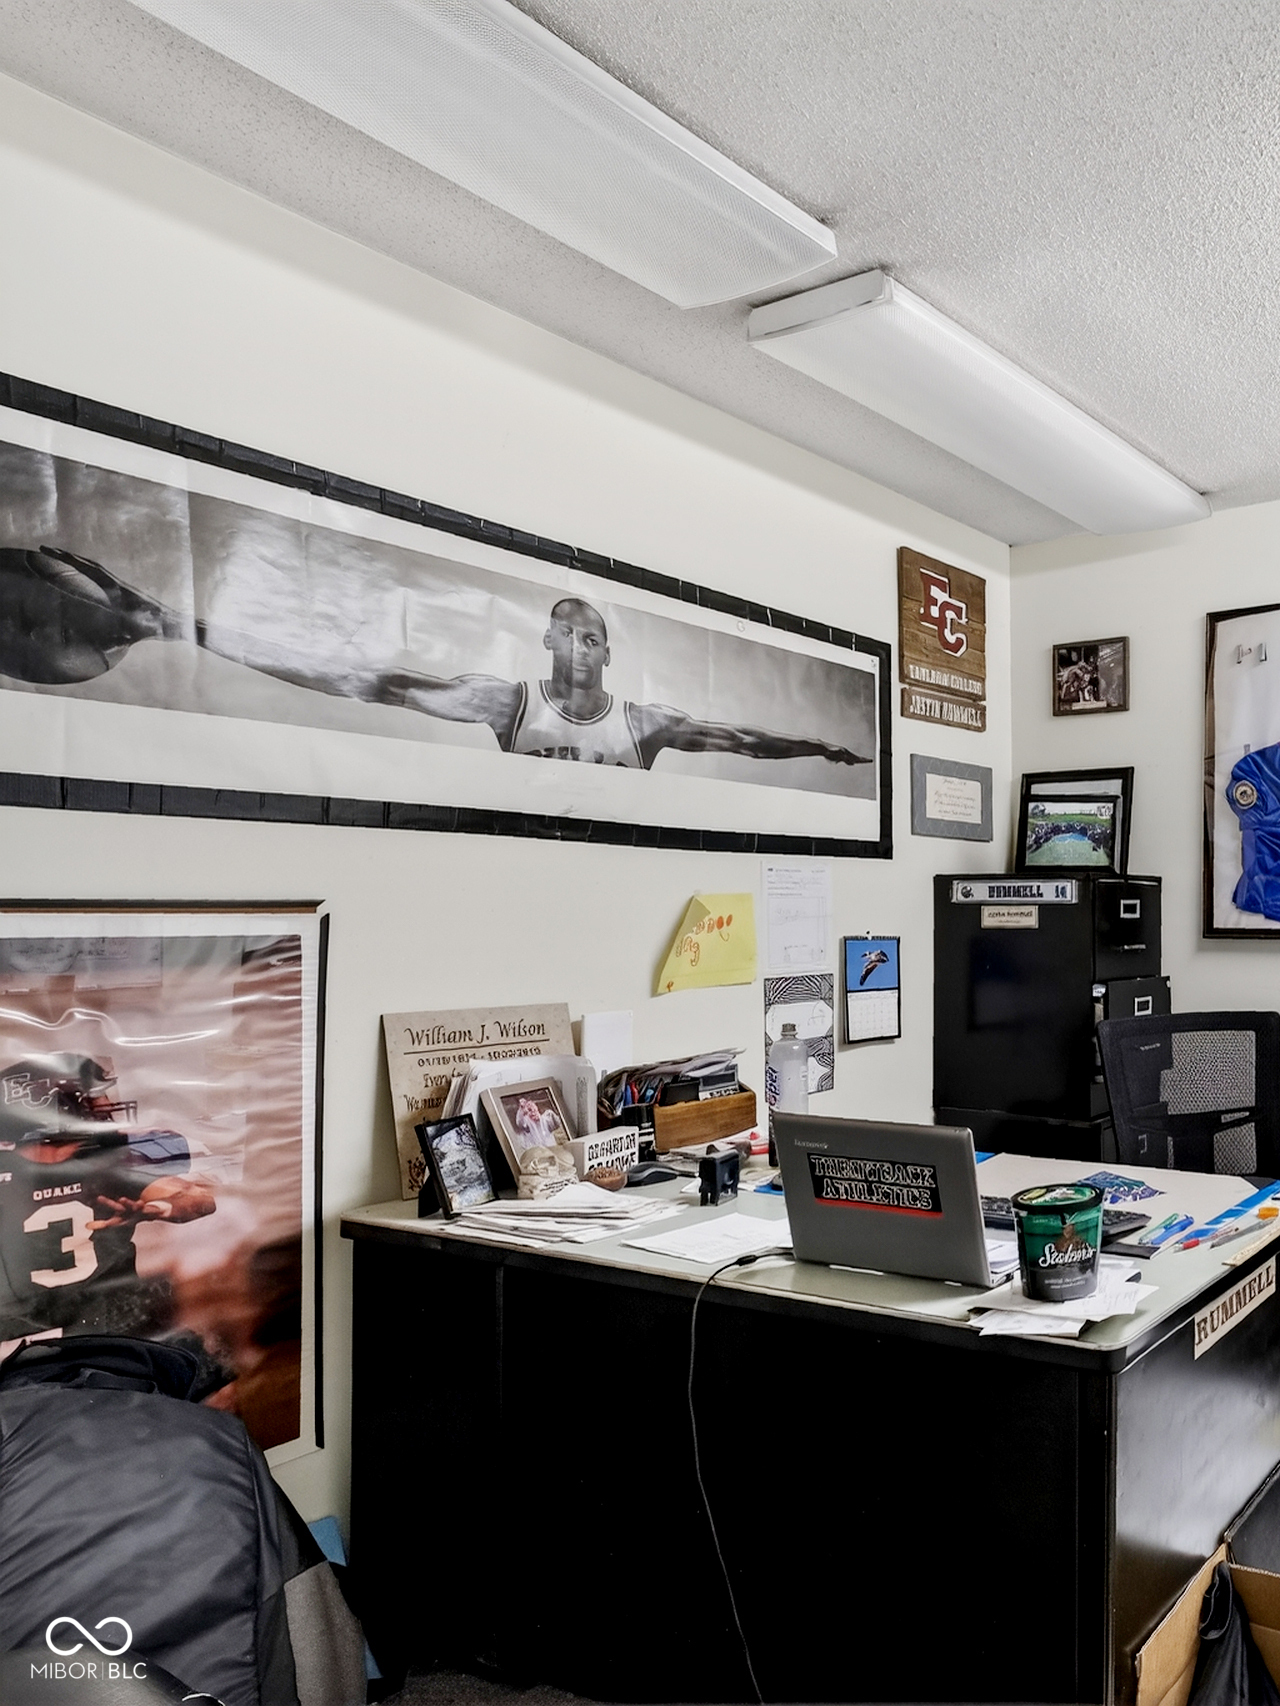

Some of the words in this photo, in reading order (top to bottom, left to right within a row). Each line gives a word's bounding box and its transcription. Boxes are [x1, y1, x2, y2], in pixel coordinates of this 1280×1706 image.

[404, 1025, 474, 1046] William
[476, 1024, 490, 1044] J.
[493, 1018, 546, 1038] Wilson
[33, 1182, 82, 1201] QUAKE
[23, 1200, 98, 1289] 3
[1194, 1265, 1275, 1346] RUMMELL
